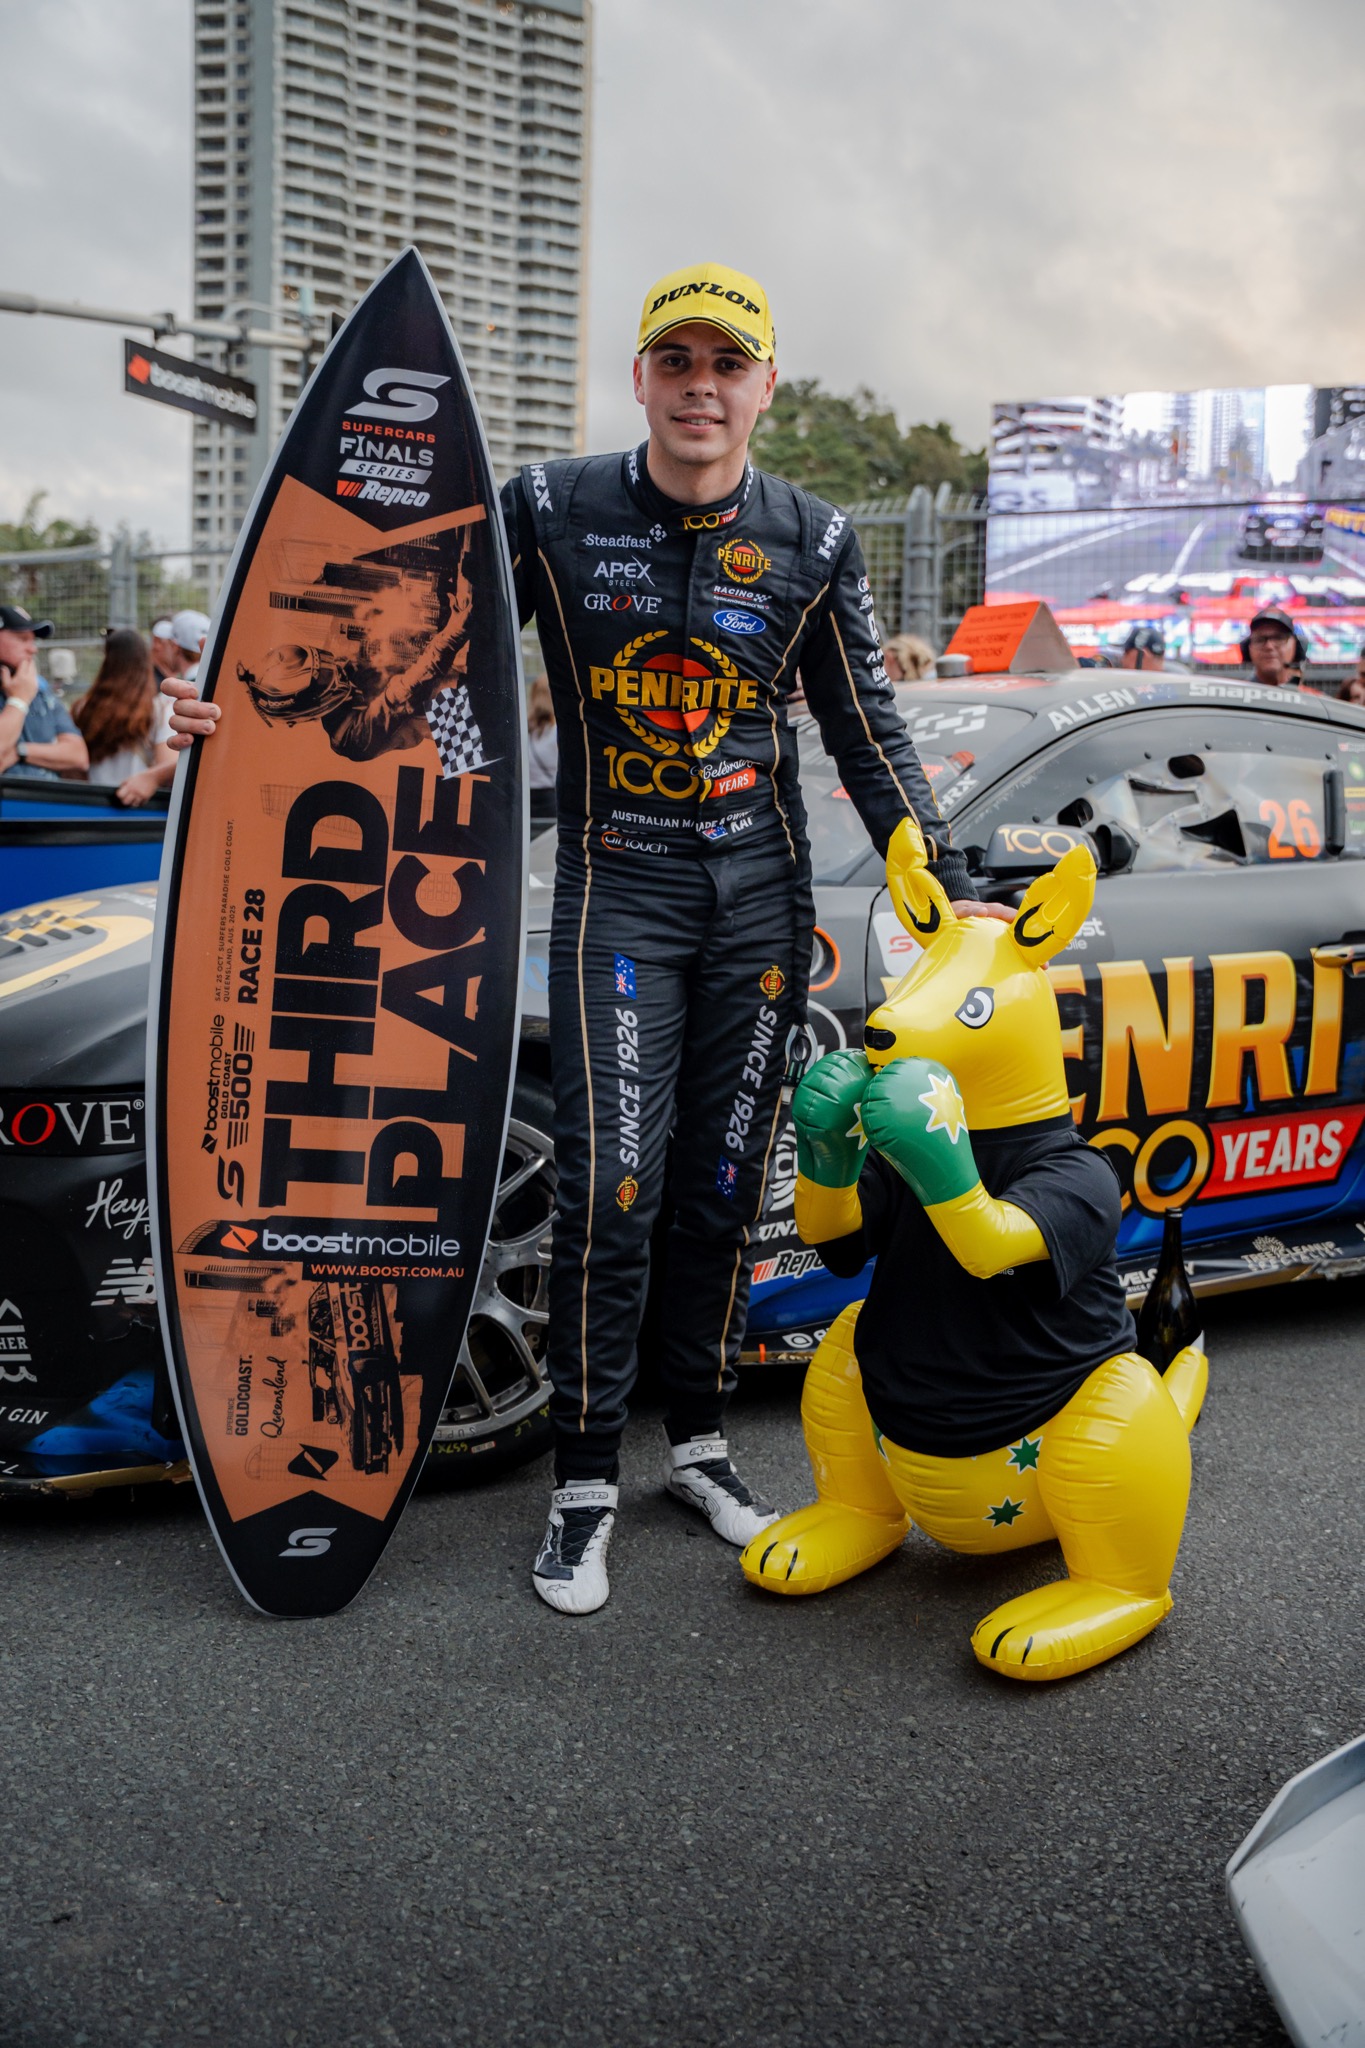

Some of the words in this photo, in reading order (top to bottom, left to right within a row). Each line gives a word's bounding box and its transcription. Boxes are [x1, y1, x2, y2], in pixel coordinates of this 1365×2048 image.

[649, 281, 761, 316] DUNLOP
[342, 421, 436, 443] SUPERCARS
[339, 435, 434, 466] FINALS
[356, 463, 415, 480] SERIES
[530, 464, 553, 512] HRX
[357, 479, 431, 508] Repco
[582, 533, 652, 550] Steadfast
[817, 510, 847, 561] HRX
[593, 558, 654, 584] APEX
[718, 547, 772, 571] PENRITE
[608, 579, 636, 587] STEEL
[713, 585, 754, 599] RACING
[722, 612, 757, 632] Ford
[589, 665, 759, 714] PENRITE
[1188, 680, 1302, 704] Snap-on
[1047, 688, 1136, 732] ALLEN
[719, 773, 749, 795] YEARS
[611, 809, 680, 828] AUSTRALIAN
[1259, 799, 1321, 859] 26
[224, 849, 232, 872] GOLD
[221, 874, 230, 914] PARADISE
[243, 888, 266, 922] 28
[228, 905, 236, 923] 2025
[218, 915, 227, 952] SURFERS
[216, 974, 223, 983] 25
[238, 928, 263, 1004] RACE
[768, 965, 779, 1000] PENRITE
[258, 779, 389, 1209] THIRD
[365, 765, 489, 1212] PLACE
[615, 1008, 640, 1074] 1926
[741, 1005, 778, 1089] SINCE
[223, 1052, 232, 1087] COAST
[229, 1053, 253, 1120] 500
[221, 1091, 230, 1119] GOLD
[724, 1090, 756, 1152] 1926
[619, 1078, 641, 1169] SINCE
[1220, 1119, 1345, 1183] YEARS
[623, 1174, 633, 1212] PENRITE
[262, 1228, 460, 1257] boostmobile
[1241, 1250, 1277, 1264] TREE
[310, 1263, 465, 1279] WWW.BOOST.COM.AU
[340, 1282, 371, 1350] boost
[260, 1355, 288, 1438] Queensland
[8, 1408, 50, 1425] GIN
[226, 1397, 235, 1435] EXPERIENCE
[436, 1426, 477, 1440] SUPE
